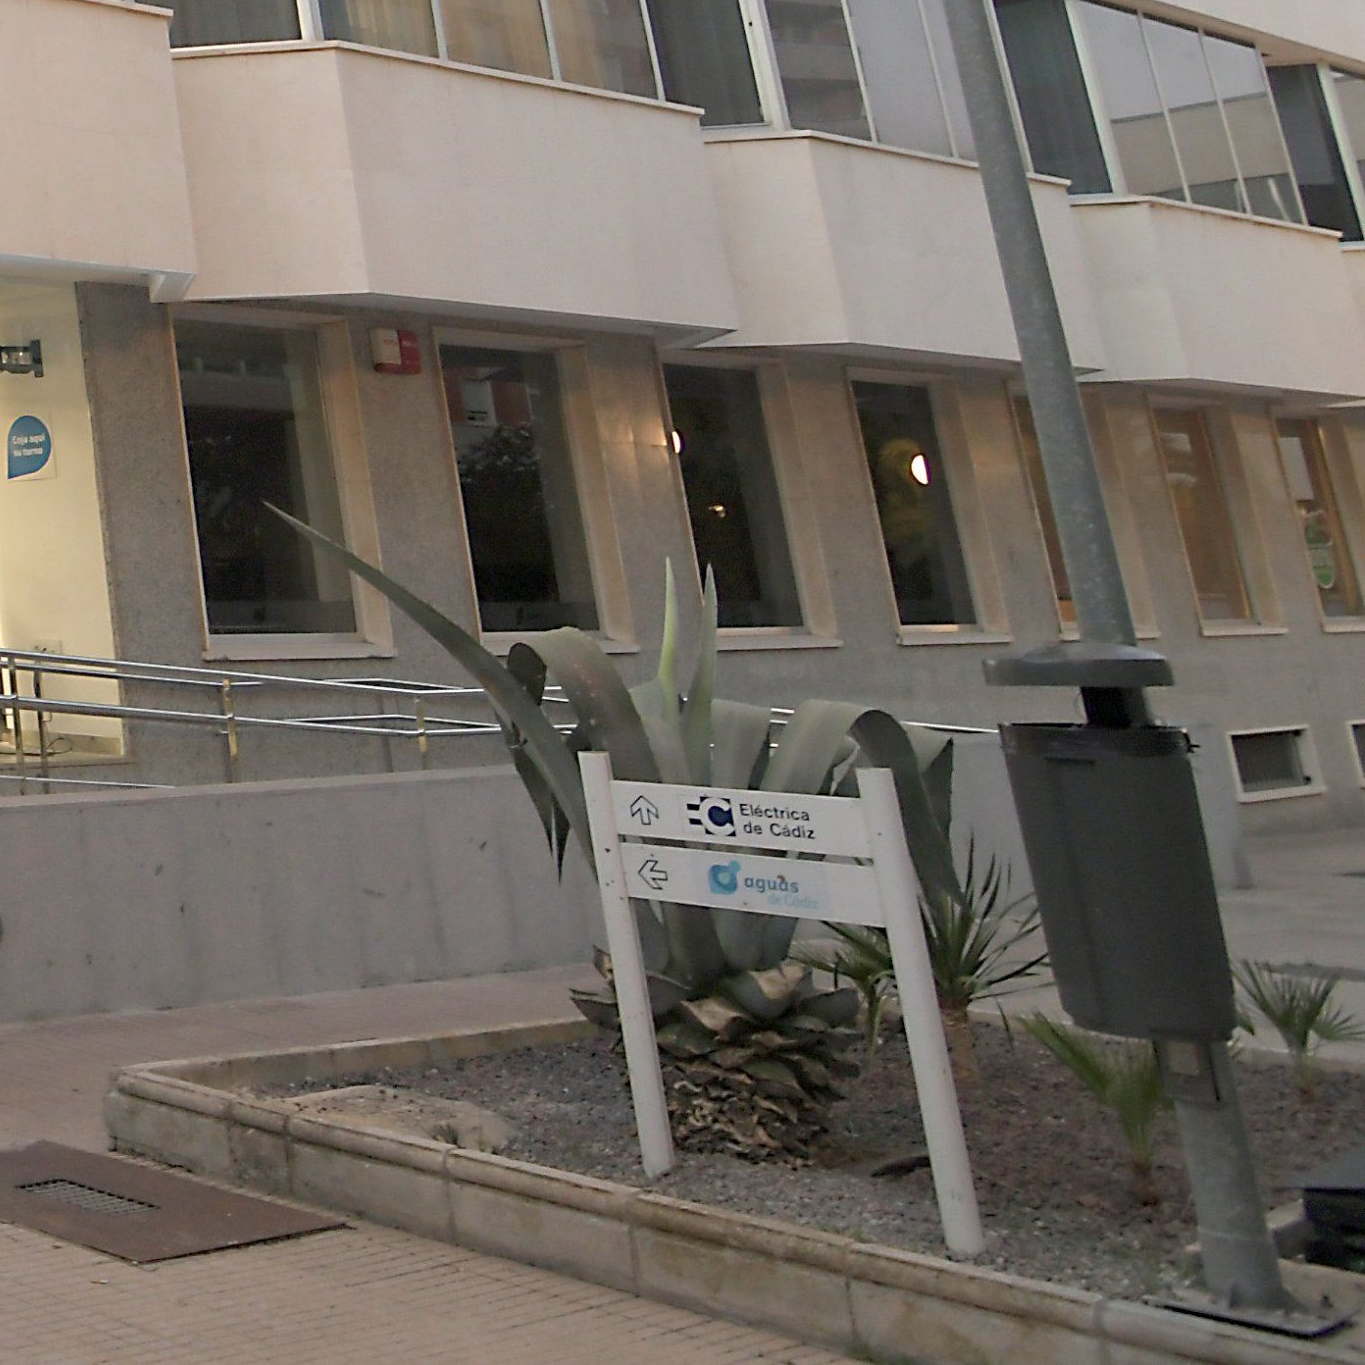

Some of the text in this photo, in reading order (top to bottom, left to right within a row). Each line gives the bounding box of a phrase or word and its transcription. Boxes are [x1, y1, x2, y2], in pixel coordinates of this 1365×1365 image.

[738, 803, 810, 821] Eléctrica
[743, 821, 816, 840] de Cádiz
[744, 877, 799, 893] aguas
